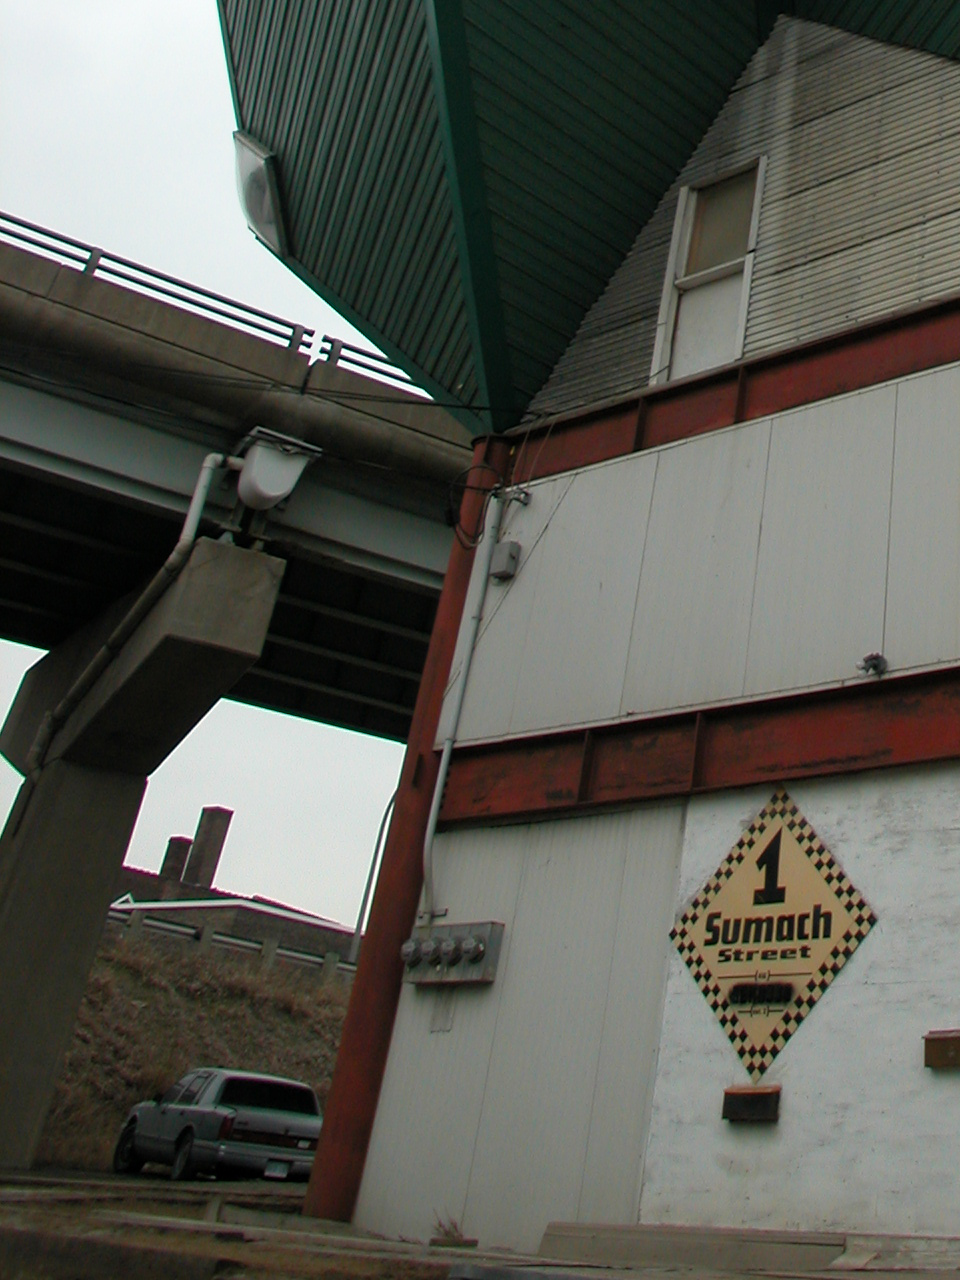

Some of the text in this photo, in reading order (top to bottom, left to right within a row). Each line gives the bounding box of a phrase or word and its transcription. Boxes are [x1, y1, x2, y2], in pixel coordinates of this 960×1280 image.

[753, 826, 787, 906] 1
[704, 904, 833, 947] Sumach
[717, 945, 811, 963] Street
